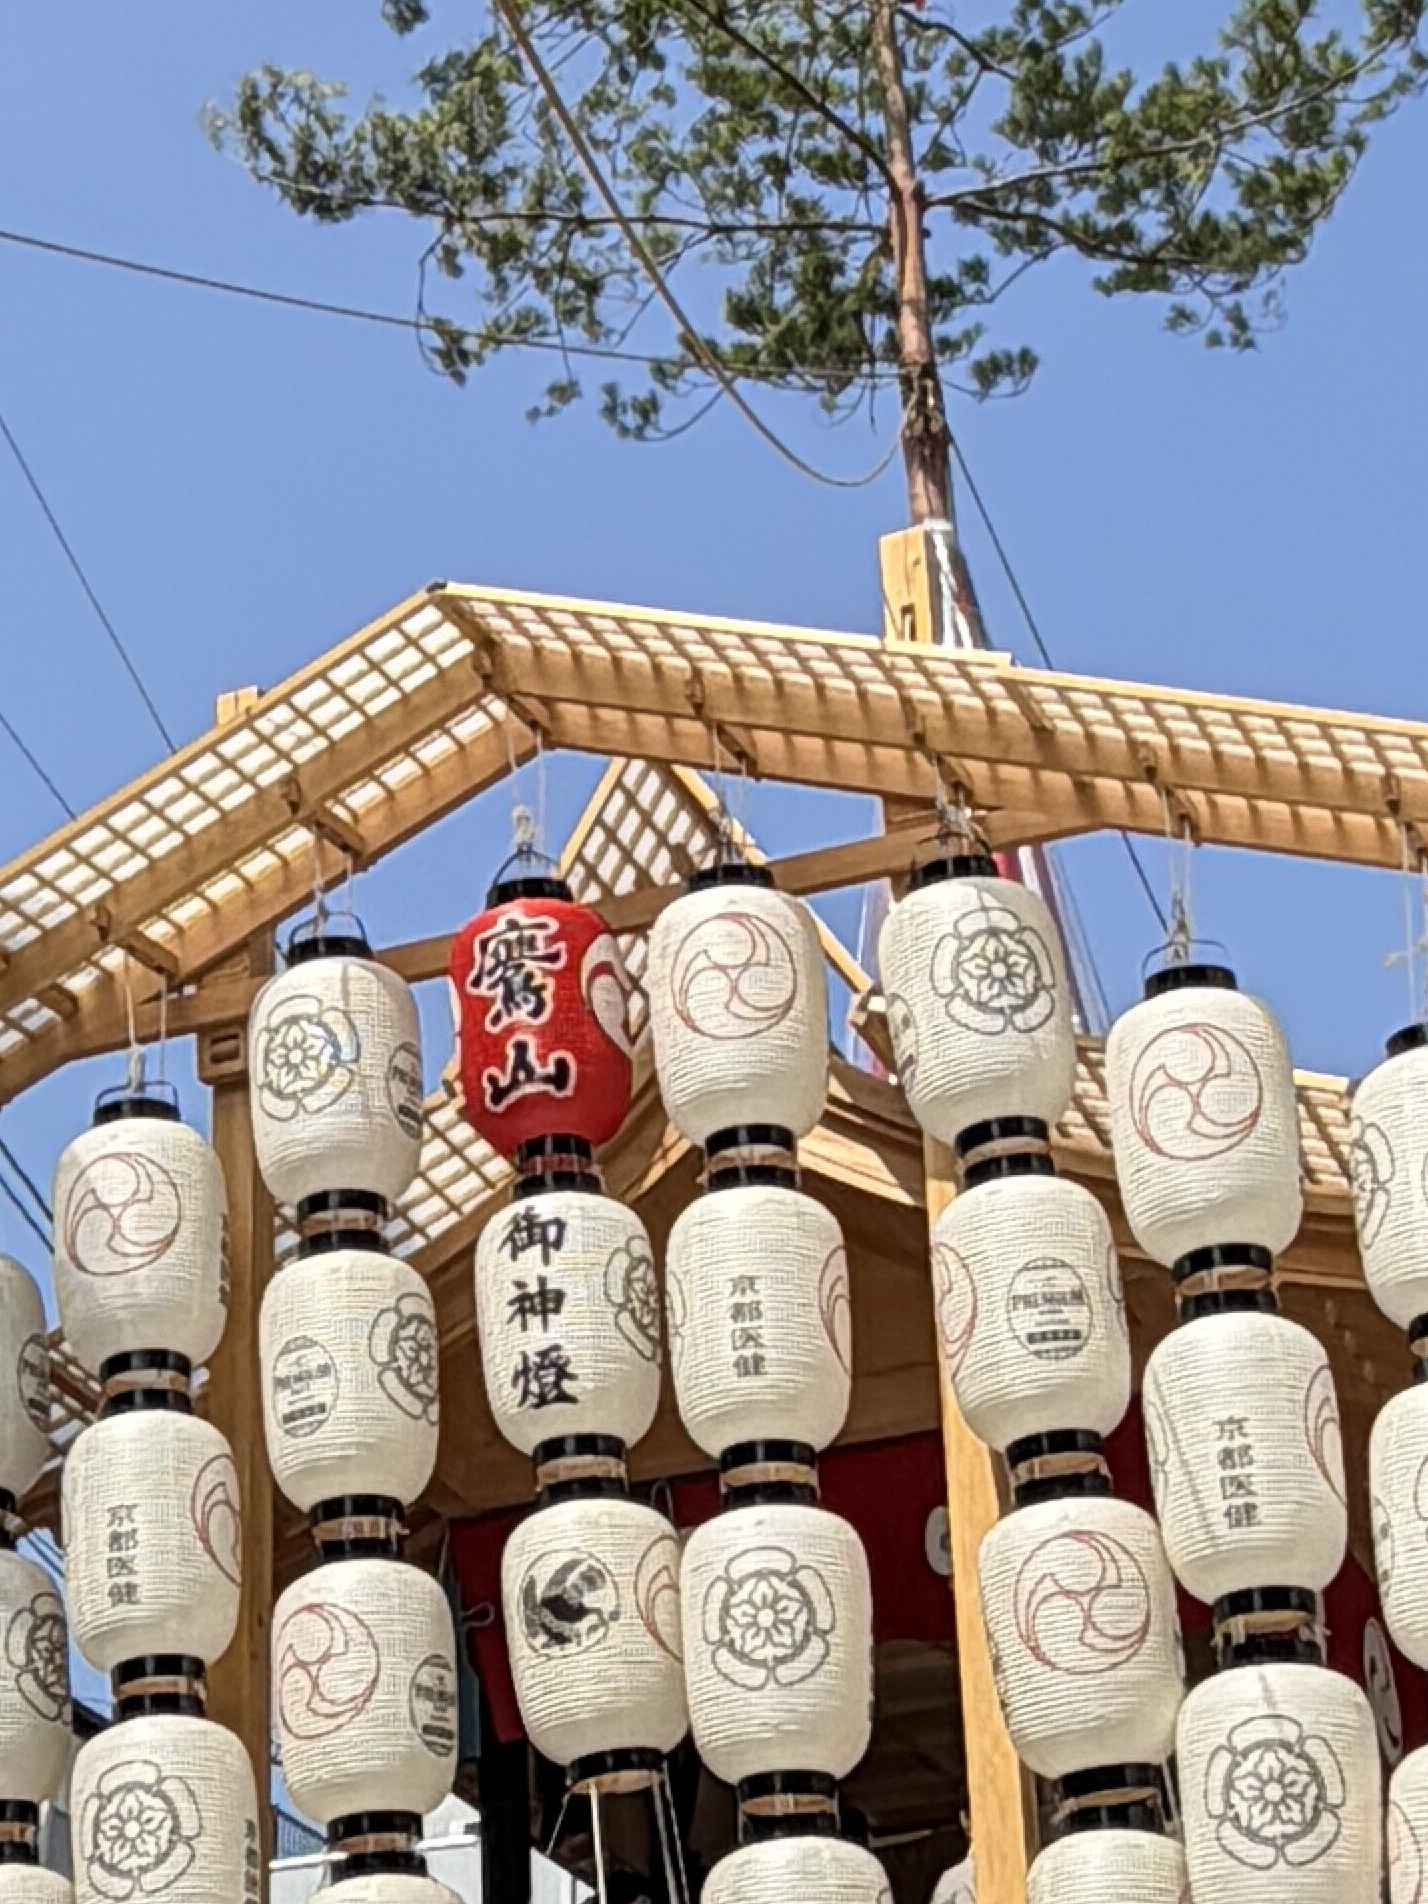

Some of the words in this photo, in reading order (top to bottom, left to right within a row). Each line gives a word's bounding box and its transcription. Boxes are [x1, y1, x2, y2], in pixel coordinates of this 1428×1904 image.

[500, 1206, 580, 1411] 御神燈
[727, 1275, 766, 1377] 京都医健
[1213, 1415, 1260, 1529] 京都医健
[106, 1504, 141, 1606] 京都医健
